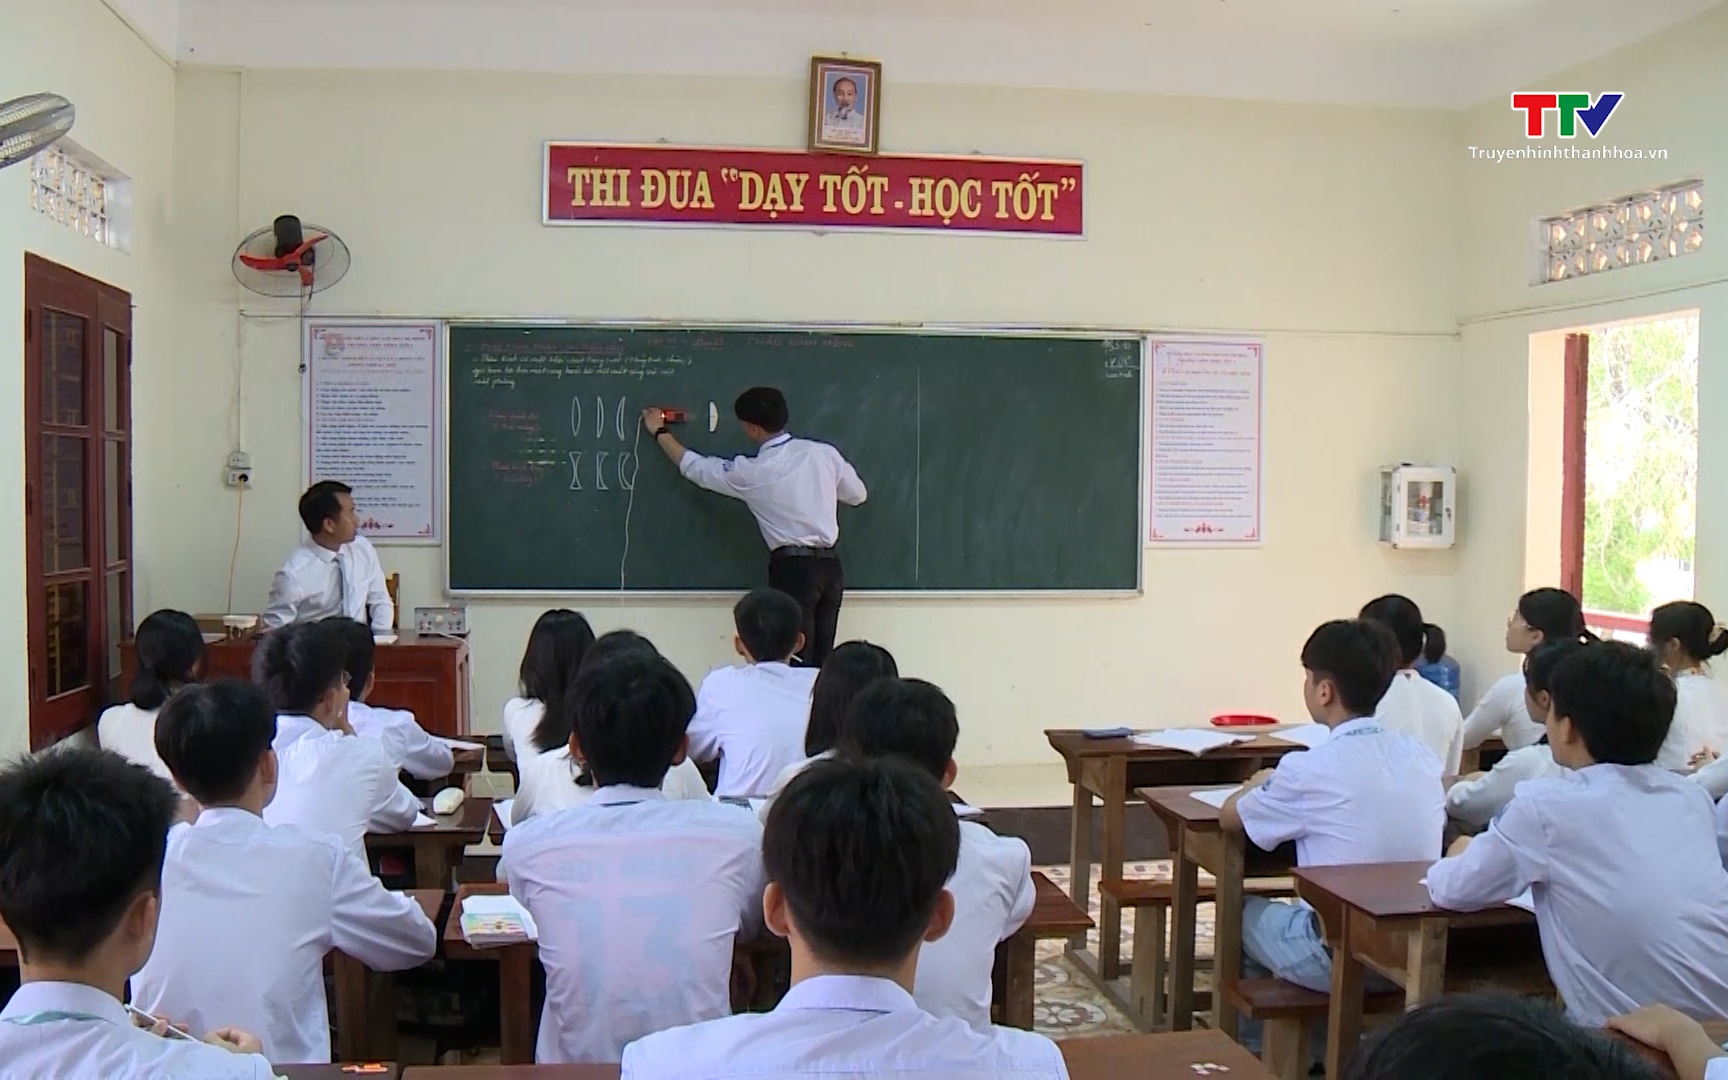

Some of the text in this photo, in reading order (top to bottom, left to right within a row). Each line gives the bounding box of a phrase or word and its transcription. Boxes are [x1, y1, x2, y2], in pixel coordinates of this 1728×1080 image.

[567, 167, 631, 207] THI
[640, 168, 715, 210] ĐUA
[819, 164, 889, 215] TỐT
[908, 177, 982, 225] HỌC
